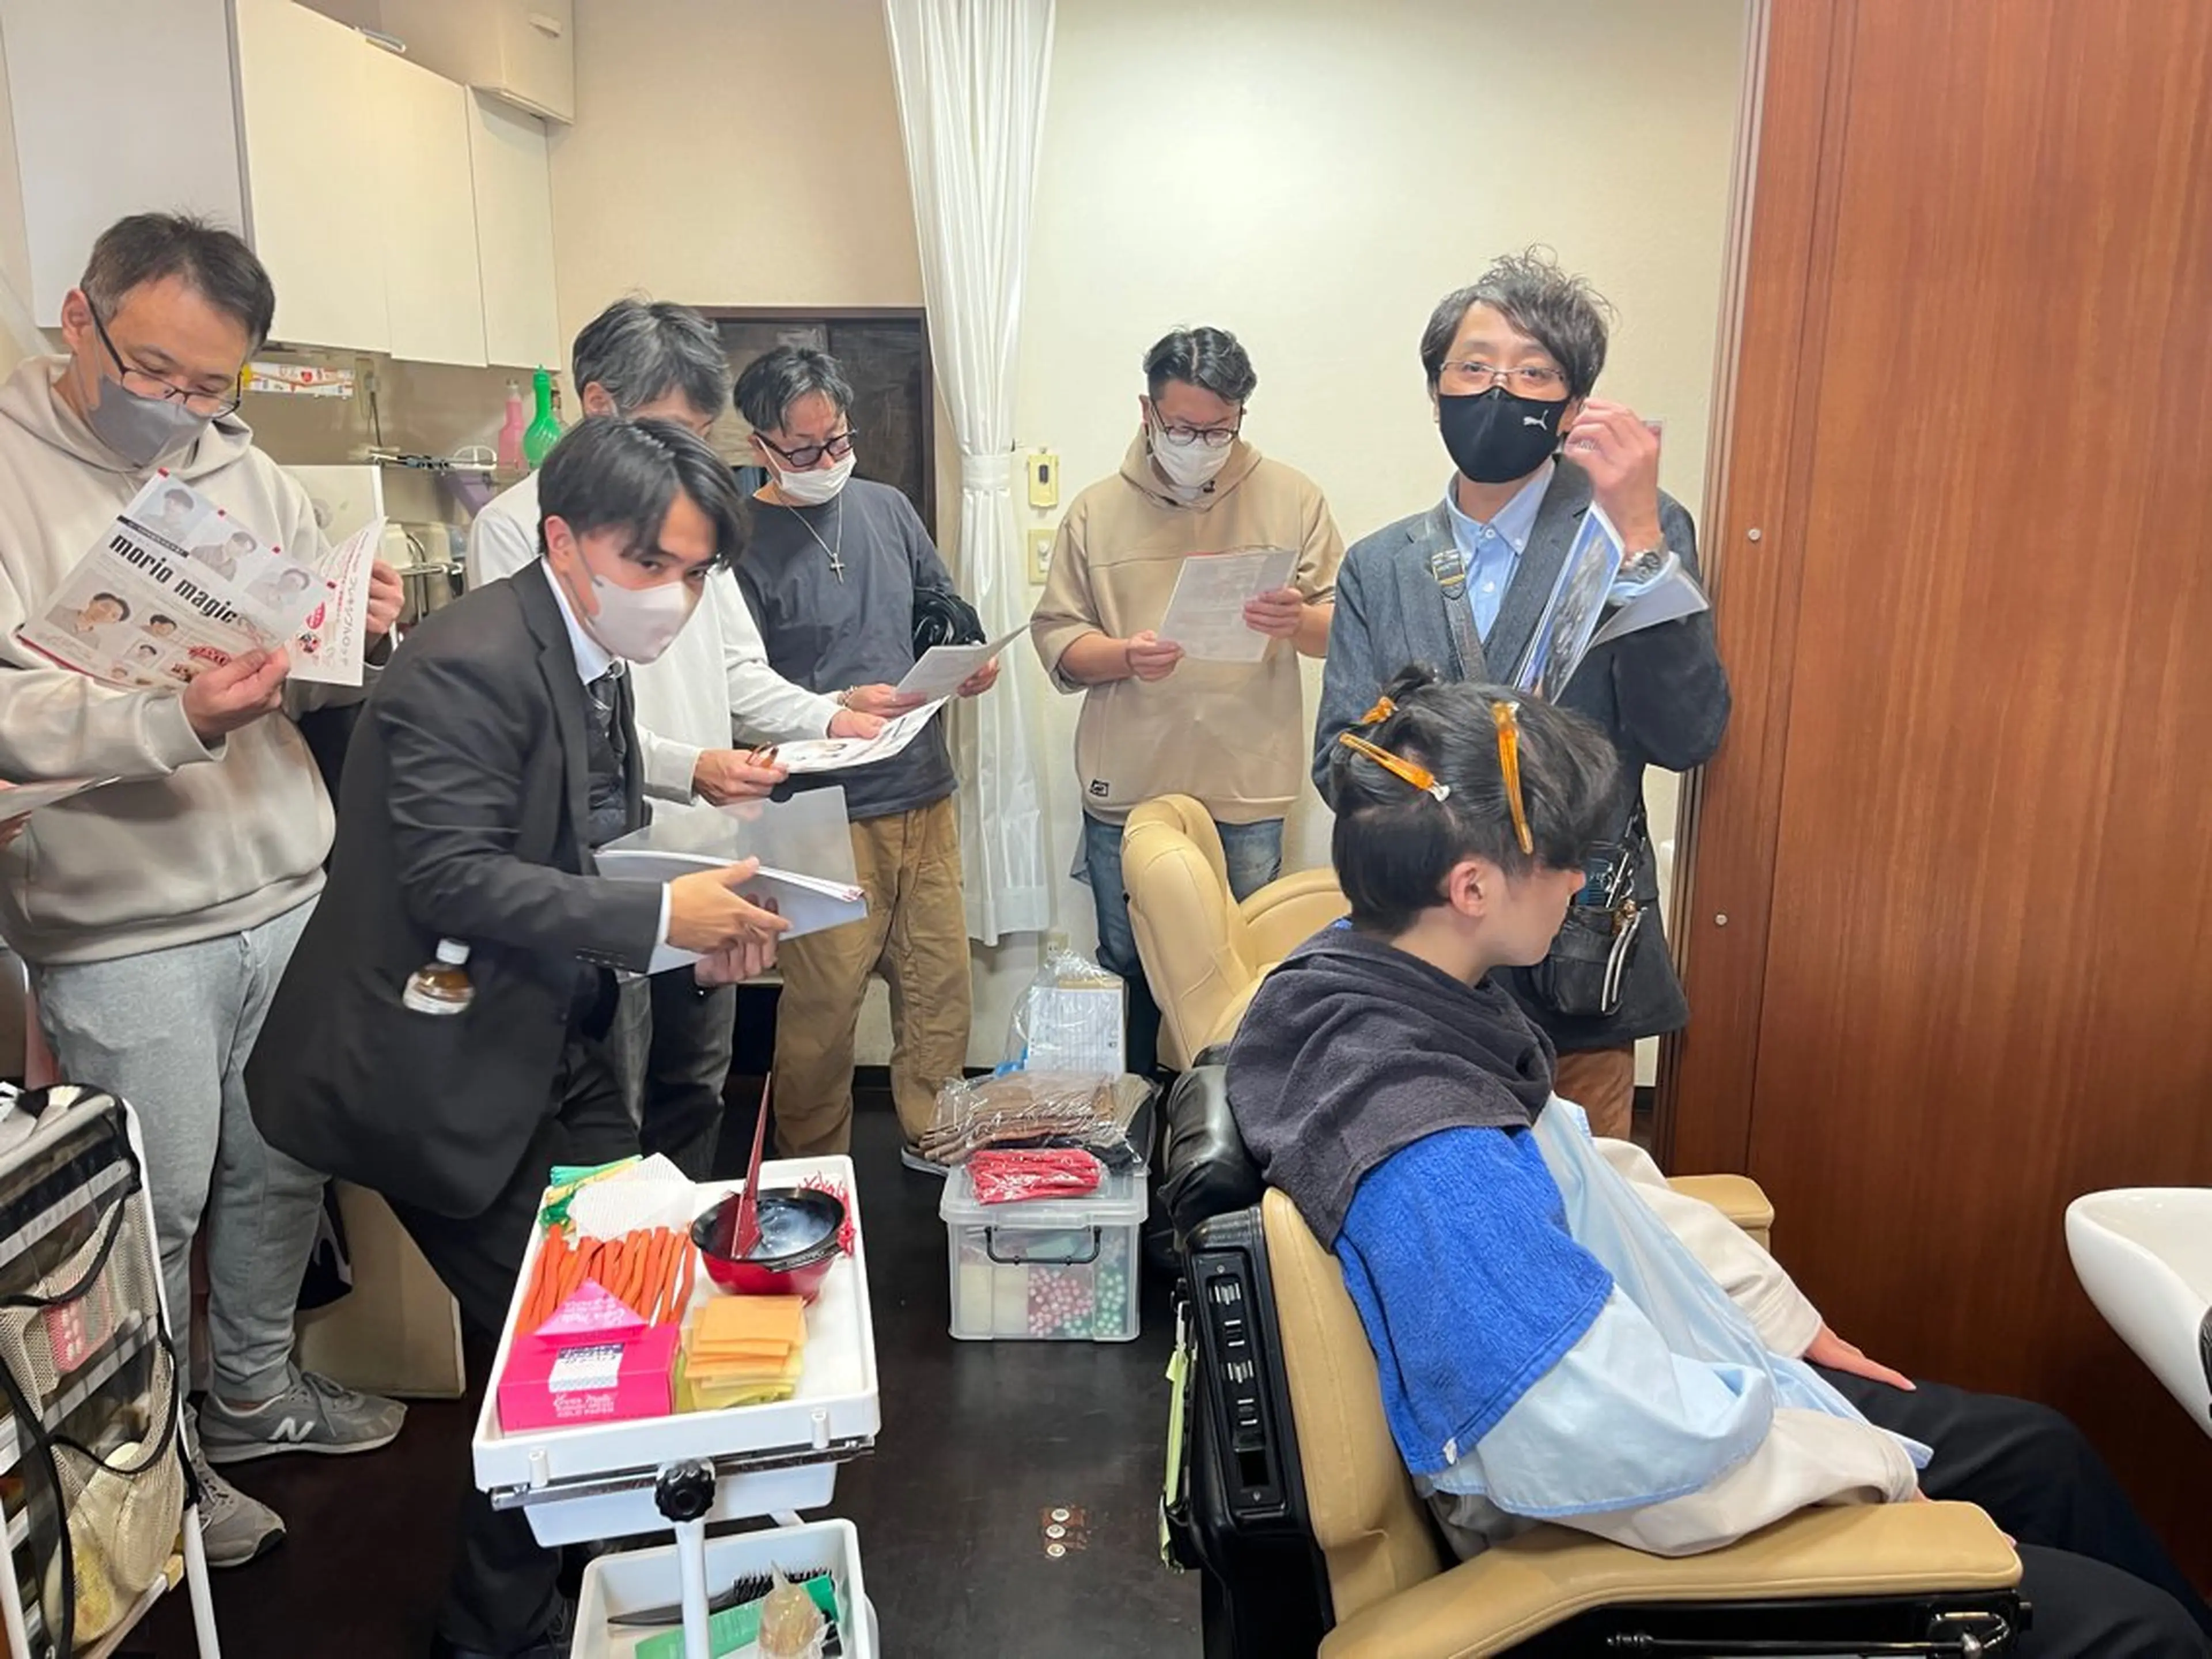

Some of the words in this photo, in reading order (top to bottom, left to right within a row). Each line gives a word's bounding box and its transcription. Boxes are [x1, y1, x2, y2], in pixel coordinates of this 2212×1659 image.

[109, 534, 174, 584] morio
[173, 578, 238, 623] magic
[268, 1416, 315, 1442] N
